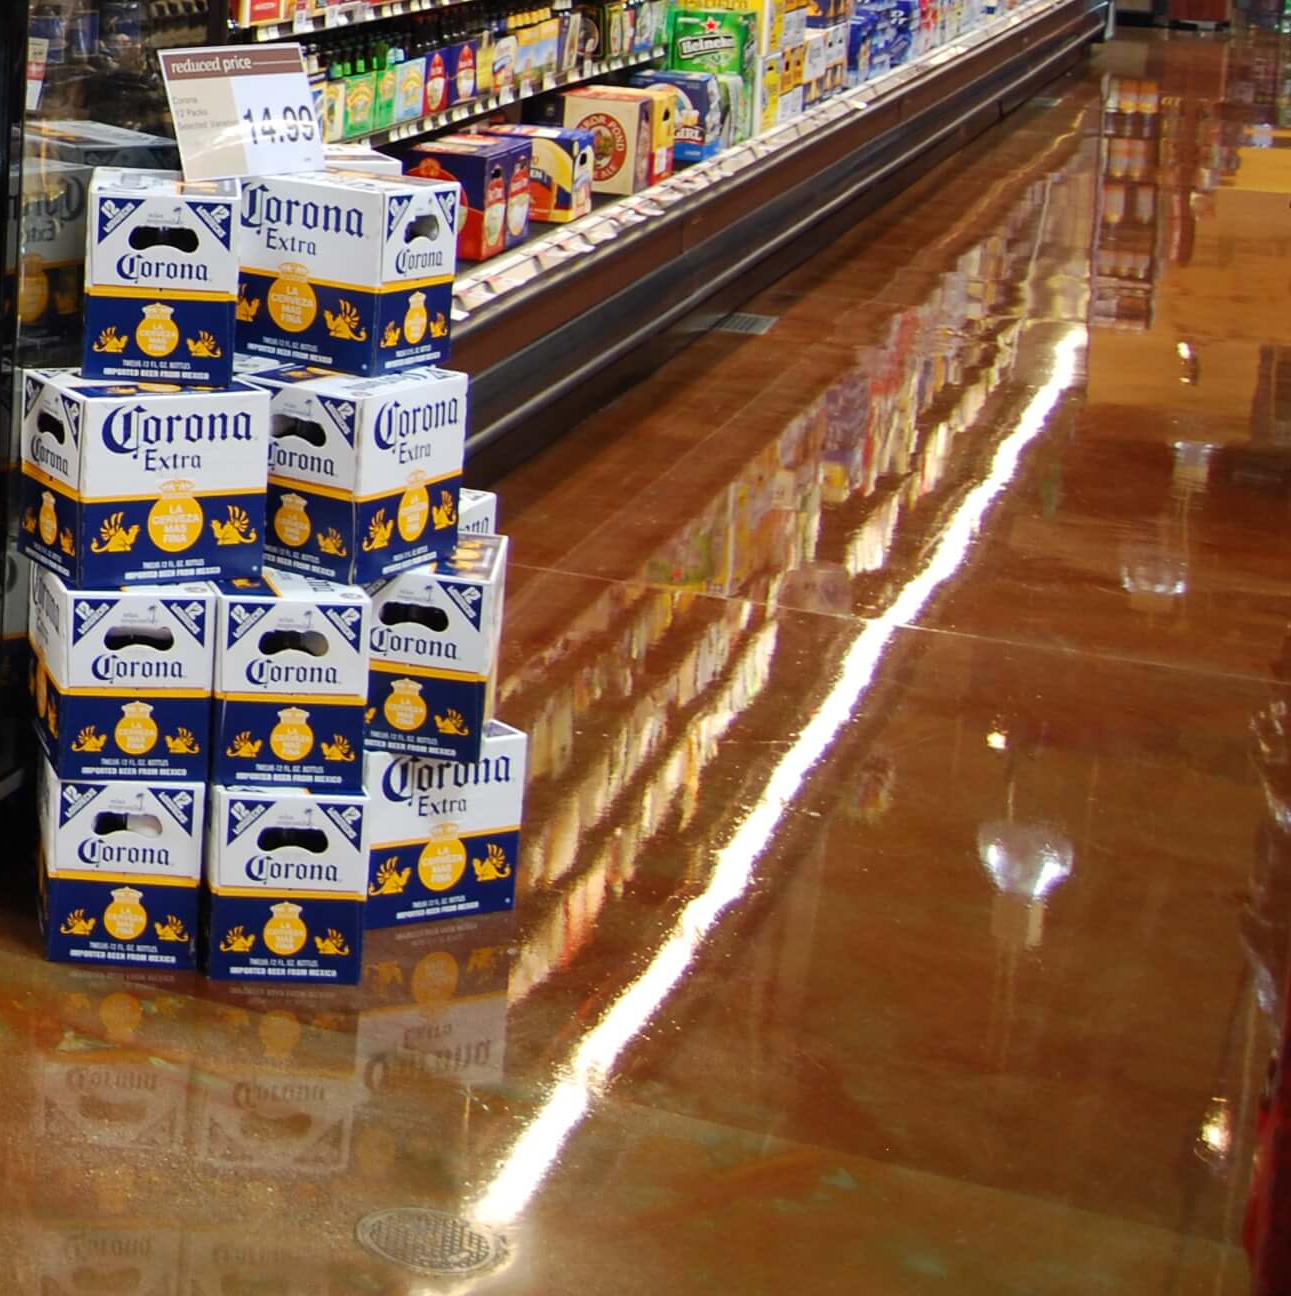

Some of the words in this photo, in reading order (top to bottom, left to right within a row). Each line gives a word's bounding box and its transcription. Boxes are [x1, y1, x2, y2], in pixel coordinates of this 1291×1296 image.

[171, 59, 221, 75] reduced
[222, 56, 253, 75] price
[242, 104, 316, 145] 14.99
[240, 181, 365, 238] Corona
[265, 227, 318, 256] Extra
[116, 253, 209, 284] Corona
[395, 248, 443, 277] Corona
[102, 405, 252, 460] Corona
[374, 397, 459, 455] Corona
[30, 434, 70, 476] Corona
[144, 448, 202, 472] Extra
[397, 443, 432, 465] Extra
[369, 625, 458, 661] Corona
[91, 654, 185, 684] Corona
[245, 658, 339, 689] Corona
[381, 754, 511, 807] Corona
[417, 794, 468, 817] Extra
[77, 837, 171, 868] Corona
[244, 855, 339, 885] Corona
